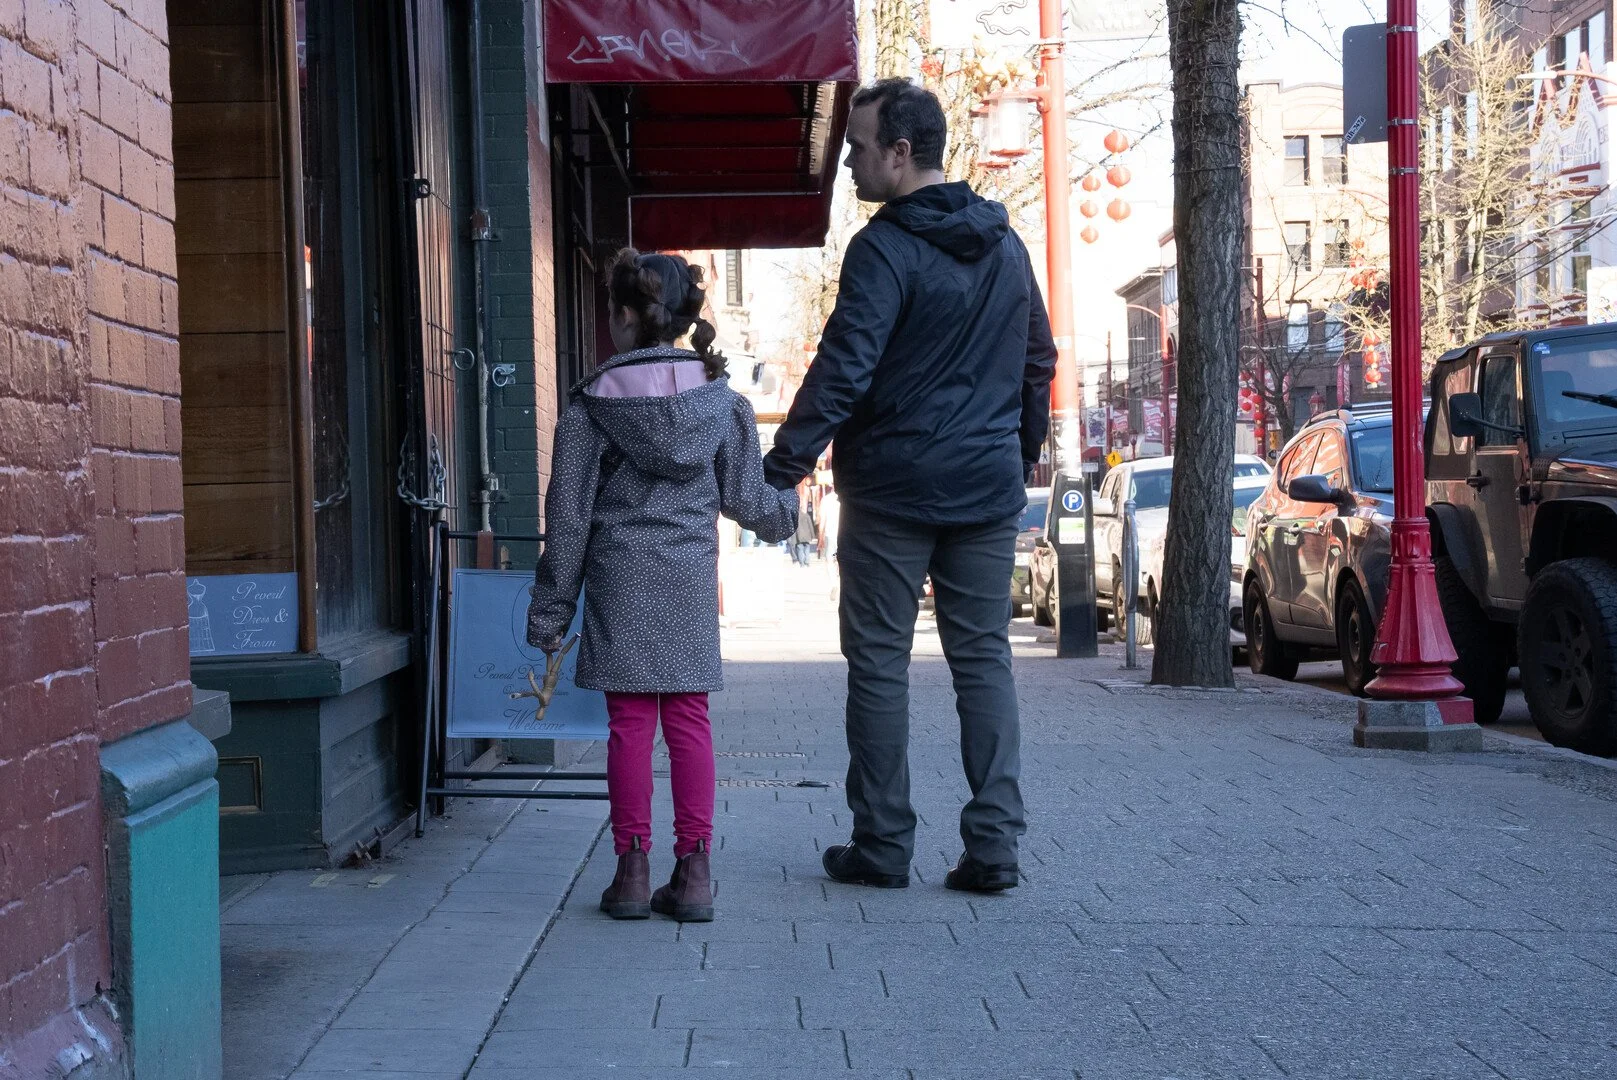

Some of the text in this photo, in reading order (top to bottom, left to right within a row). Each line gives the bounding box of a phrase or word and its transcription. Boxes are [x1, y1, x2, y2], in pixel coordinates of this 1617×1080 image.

[1068, 493, 1079, 508] P
[231, 581, 287, 601] Peveril
[232, 604, 289, 625] Dress &
[503, 708, 566, 731] Welcome
